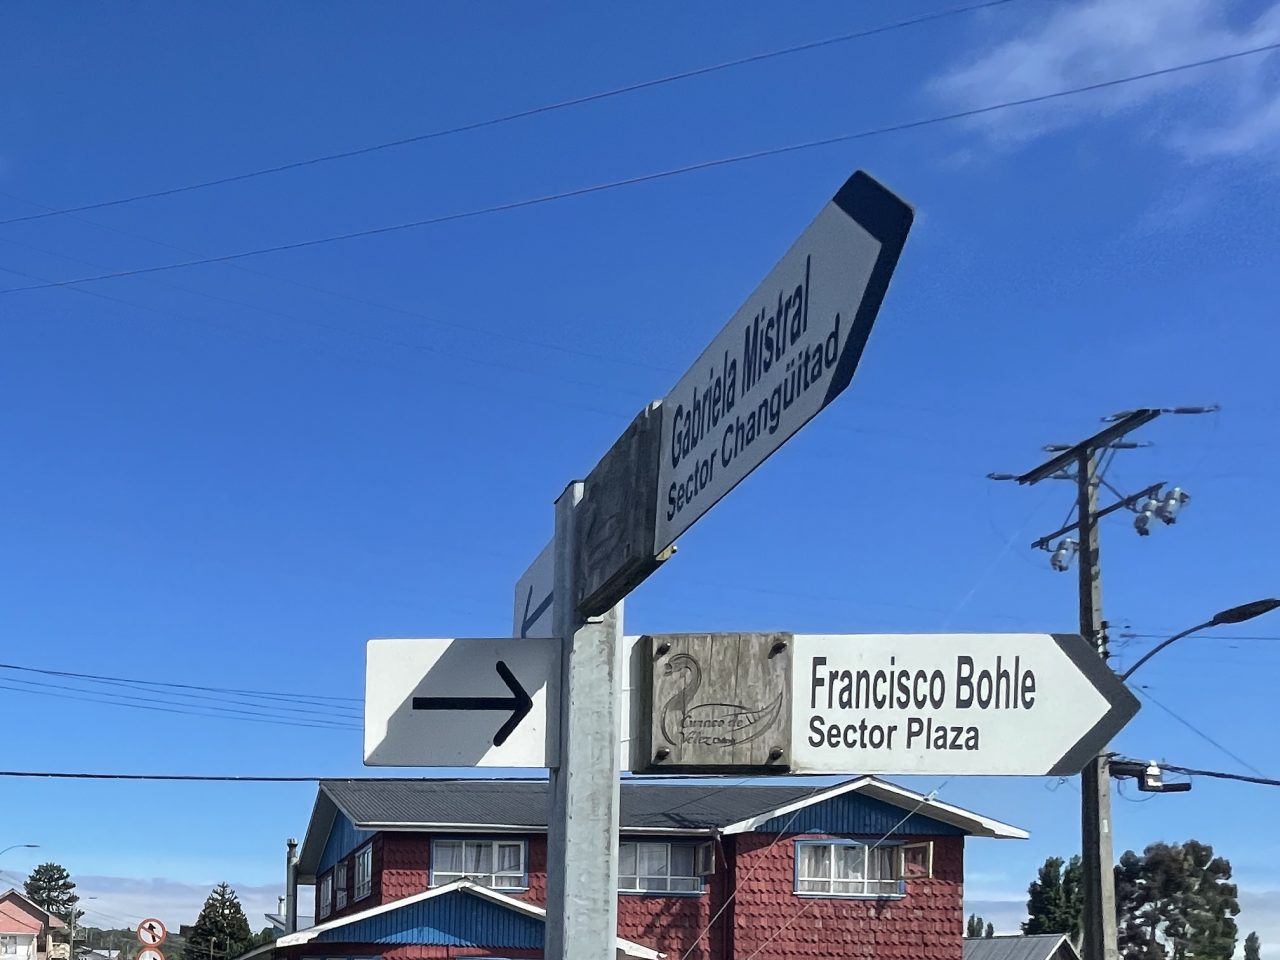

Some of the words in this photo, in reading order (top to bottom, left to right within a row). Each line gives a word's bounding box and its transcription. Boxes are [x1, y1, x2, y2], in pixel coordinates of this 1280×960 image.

[667, 448, 718, 522] Sector
[721, 312, 841, 469] Changüitad
[671, 350, 737, 470] Gabriela
[741, 254, 811, 398] Mistral
[808, 715, 897, 749] Sector
[906, 717, 980, 751] Plaza
[811, 656, 946, 710] Francisco
[955, 655, 1036, 710] Bohle
